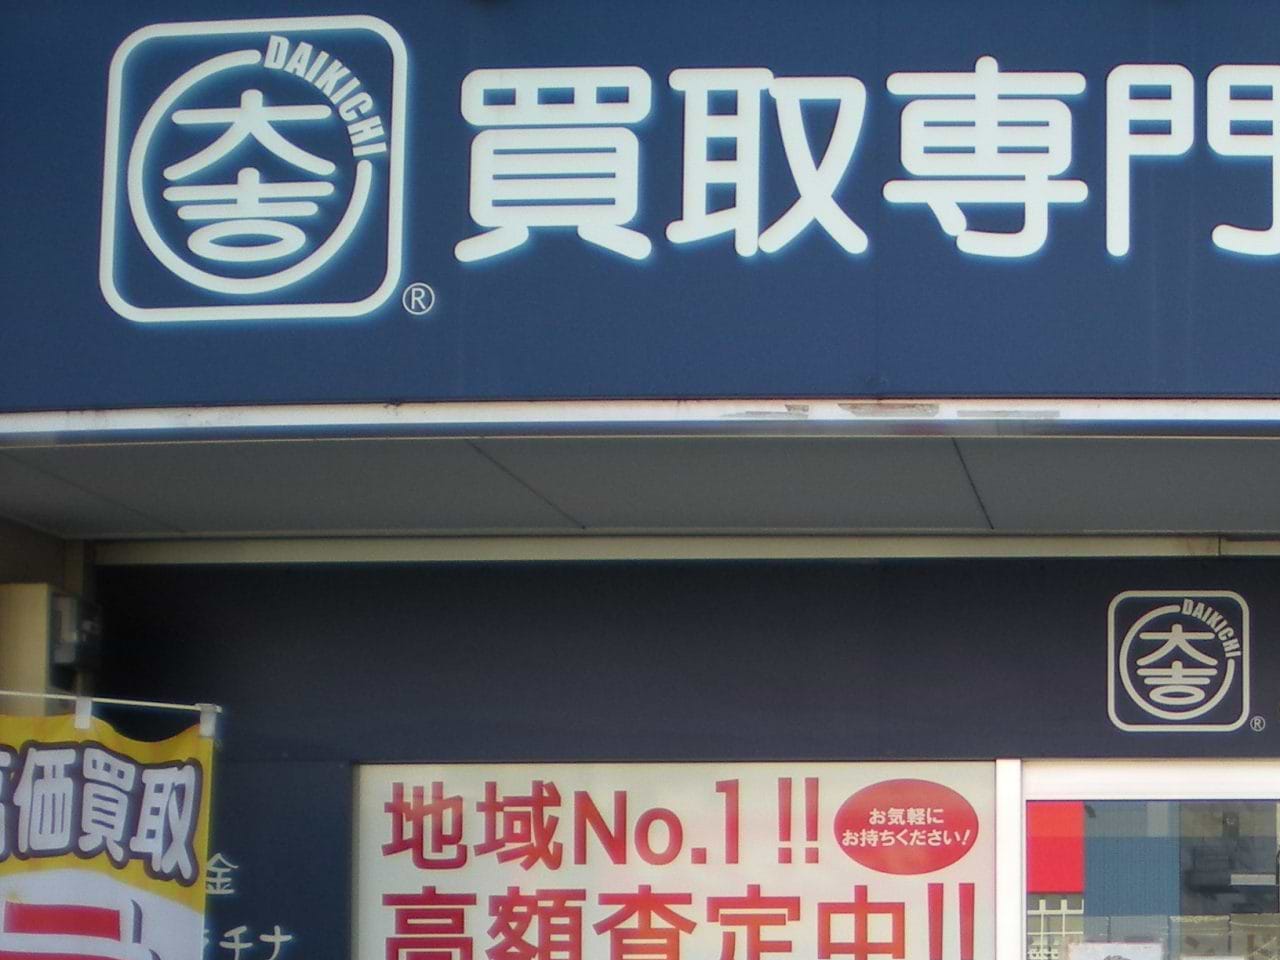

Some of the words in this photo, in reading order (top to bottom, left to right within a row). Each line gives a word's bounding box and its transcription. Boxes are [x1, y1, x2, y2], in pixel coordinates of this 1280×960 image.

[264, 35, 388, 158] DAIKICHI
[1182, 598, 1242, 658] DAIKICHI
[0, 746, 197, 880] 価買取
[381, 776, 820, 871] 地域No.1!!
[842, 828, 971, 847] お持ちください!
[868, 807, 945, 825] お気軽に
